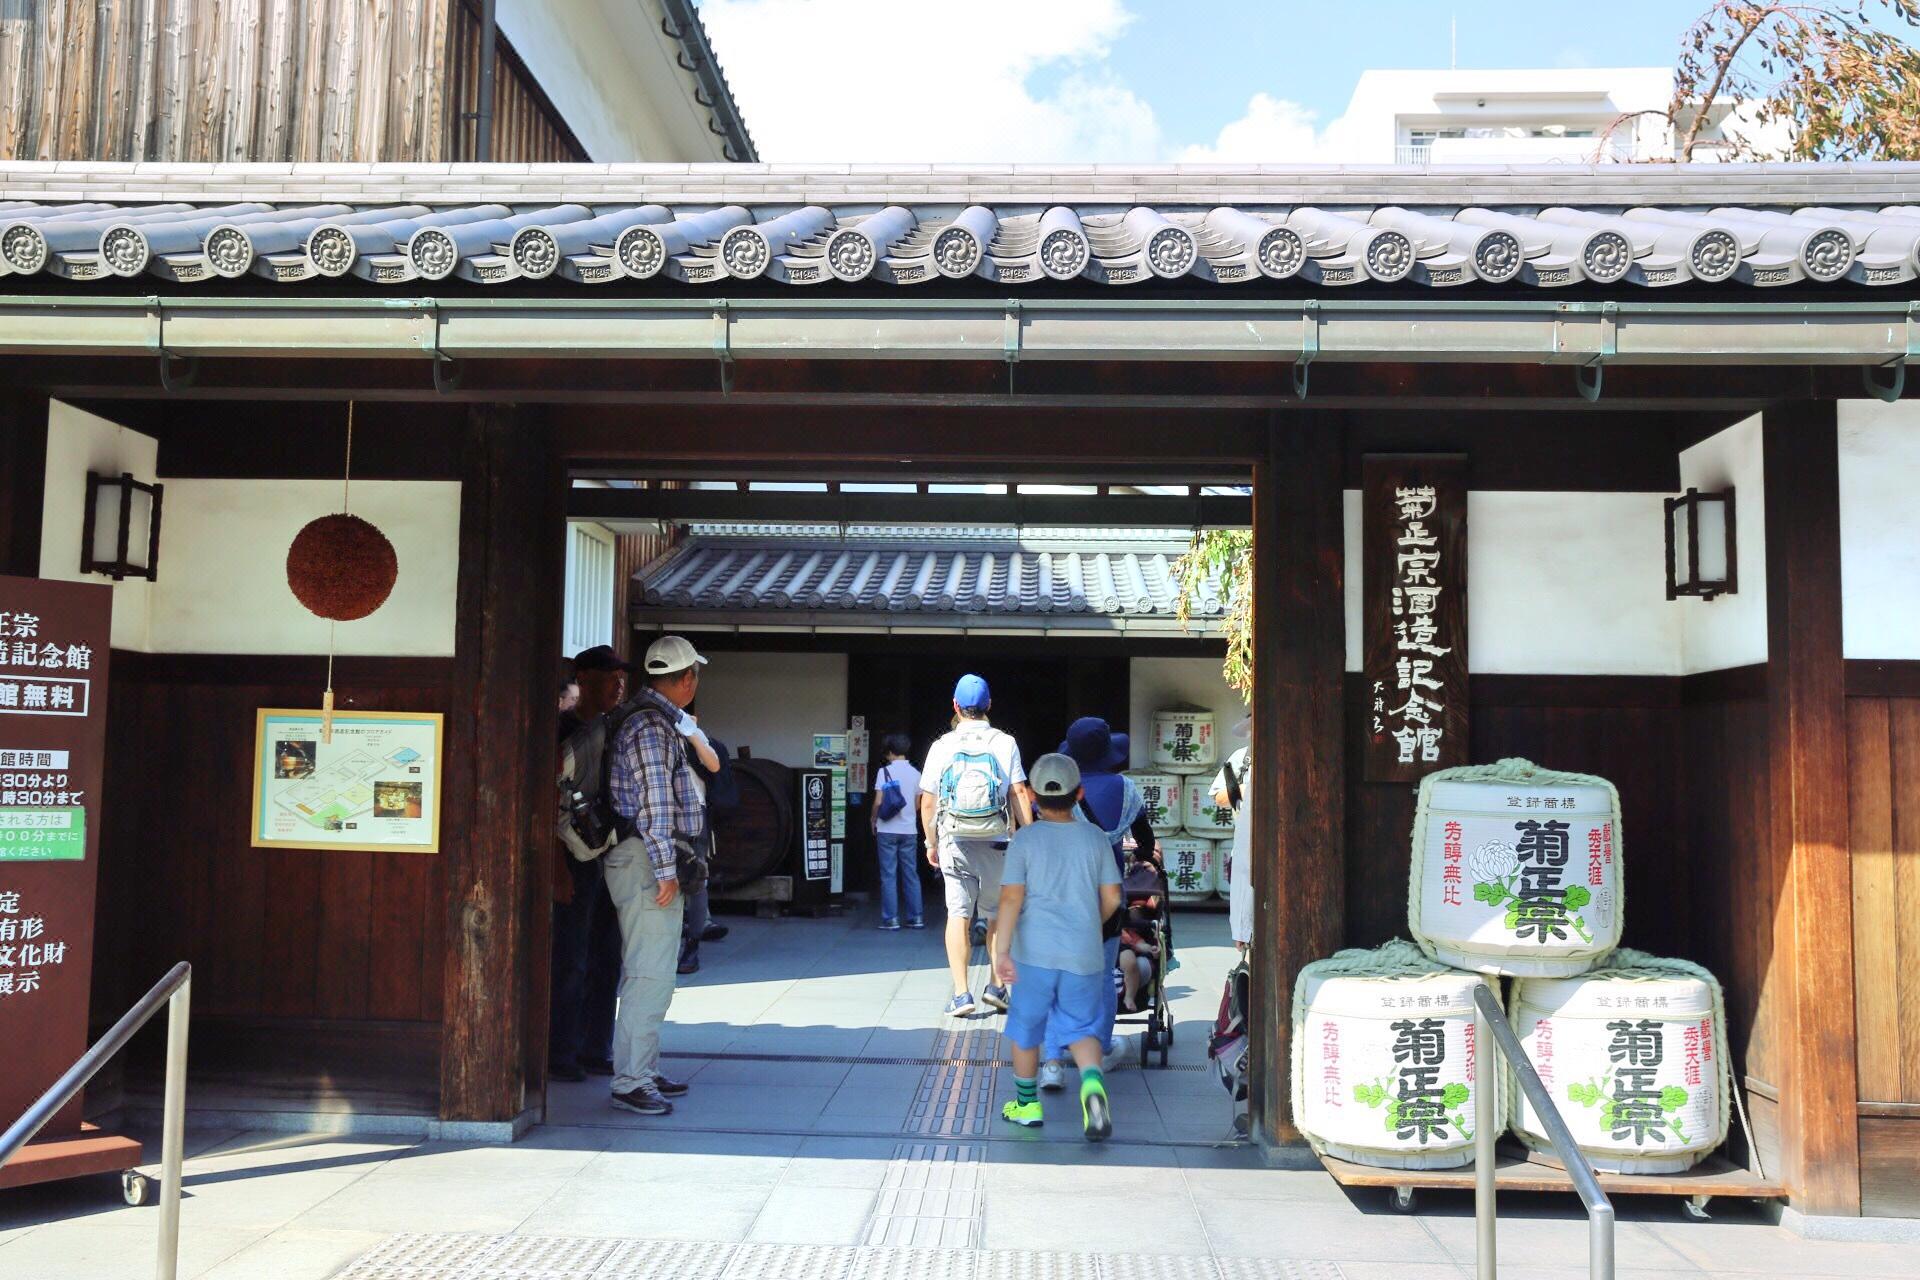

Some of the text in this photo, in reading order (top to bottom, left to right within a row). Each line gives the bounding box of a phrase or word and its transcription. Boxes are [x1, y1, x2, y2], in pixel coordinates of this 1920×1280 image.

[1389, 485, 1451, 763] 菊正宗酒造記念館
[0, 682, 74, 709] 館無料
[0, 752, 51, 767] 館時間
[1175, 723, 1194, 763] 菊正宗
[0, 773, 68, 788] 30分より
[0, 791, 84, 806] 時30分まで
[1178, 851, 1195, 890] 菊正宗
[1443, 821, 1463, 906] 芳醇無比
[1514, 819, 1571, 944] 菊正宗
[0, 918, 44, 940] 有形
[0, 942, 66, 967] 文化財
[1323, 1021, 1342, 1107] 芳醇無比
[1536, 1020, 1553, 1094] 芳醇無
[1390, 1018, 1449, 1145] 菊正宗
[1606, 1018, 1667, 1146] 菊正宗
